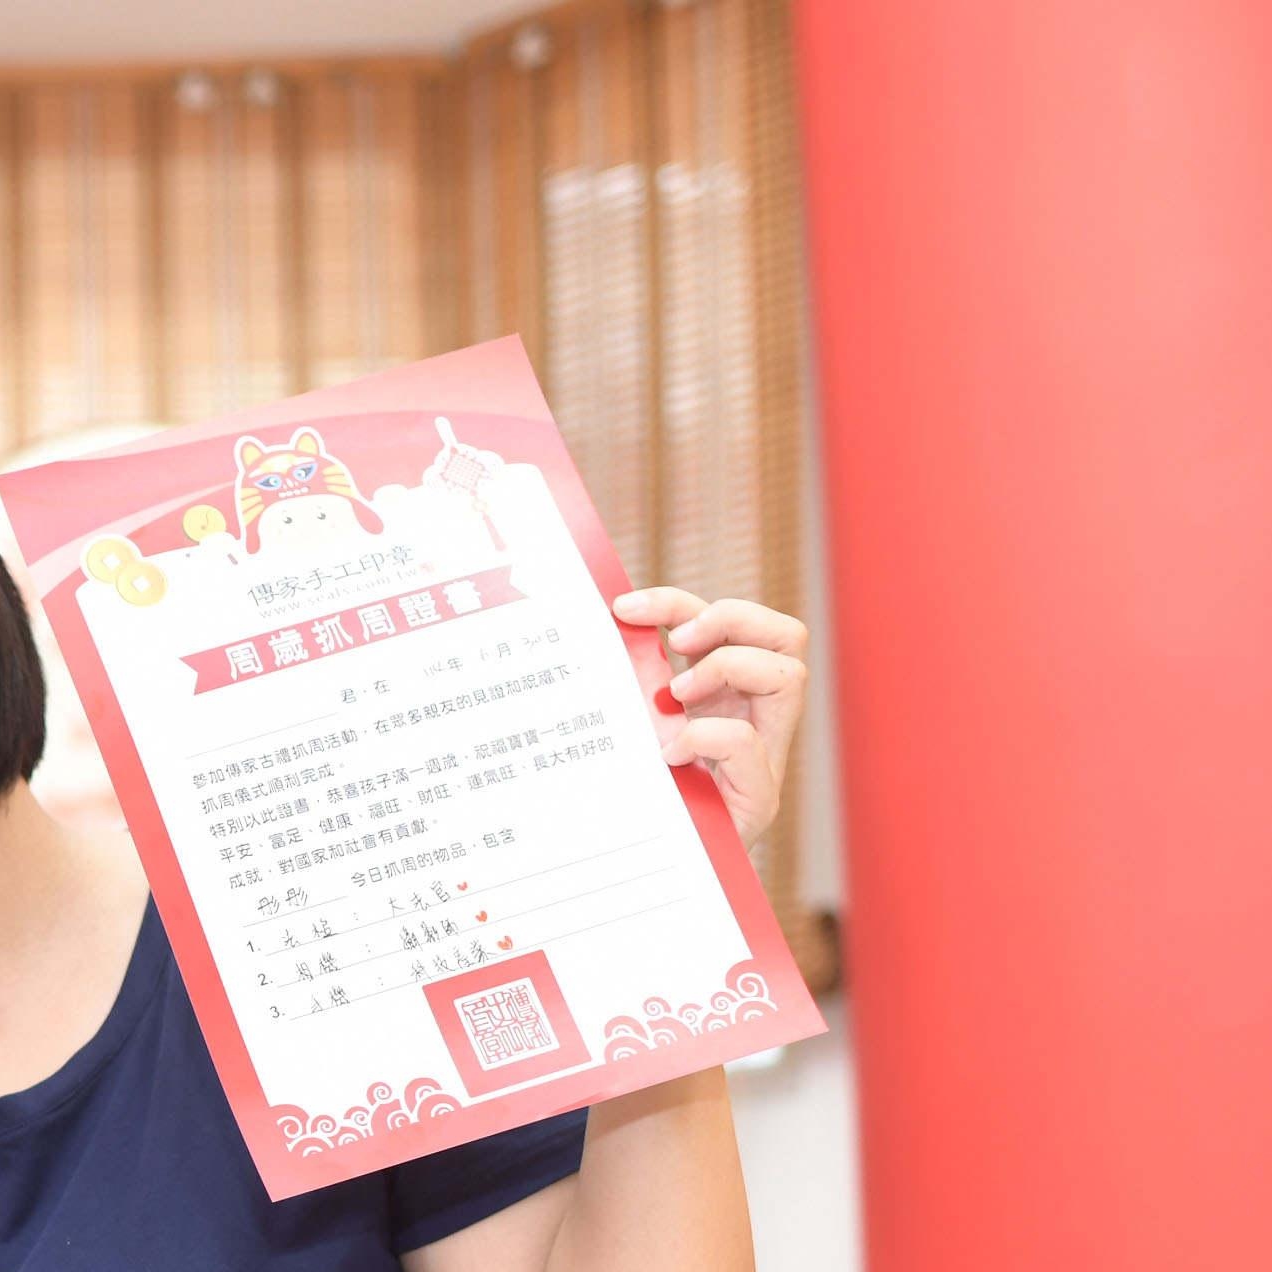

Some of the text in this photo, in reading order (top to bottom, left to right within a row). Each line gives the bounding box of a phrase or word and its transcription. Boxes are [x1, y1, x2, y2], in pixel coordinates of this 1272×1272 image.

[247, 545, 414, 607] 傳家手工印章
[225, 579, 483, 681] 周歲抓周證書
[246, 940, 261, 953] 1.
[257, 973, 273, 987] 2.
[269, 1006, 285, 1019] 3.
